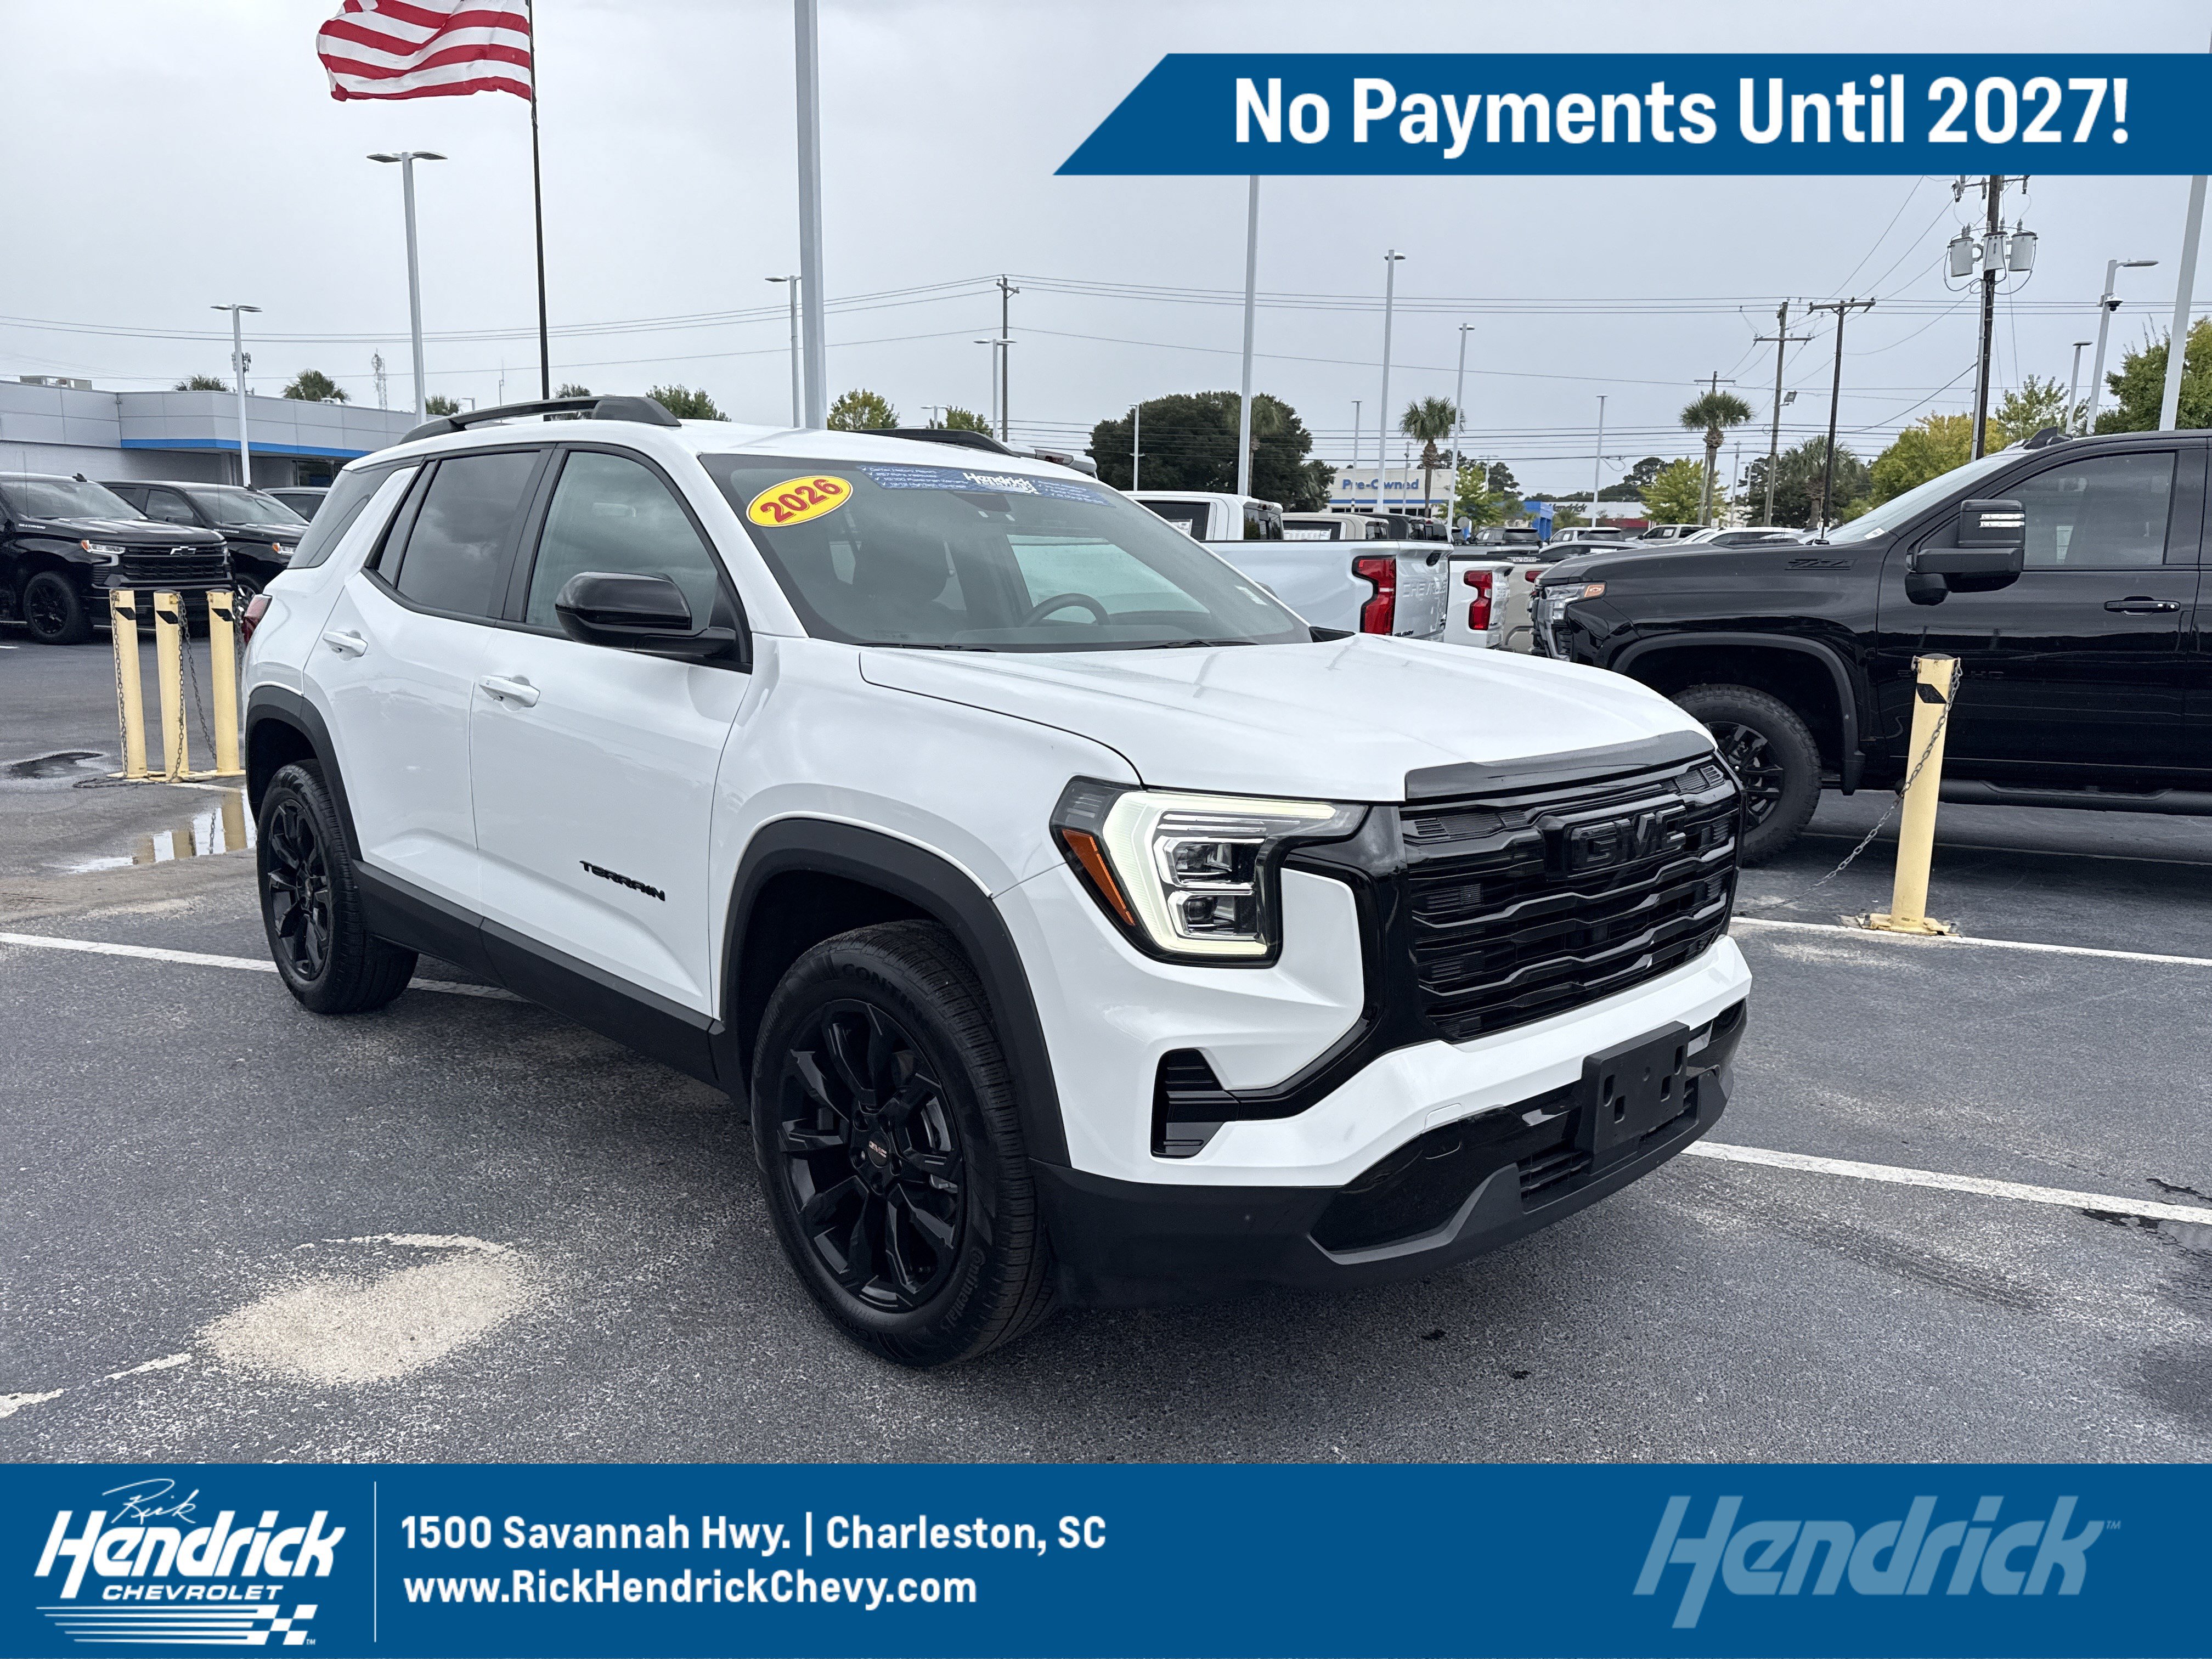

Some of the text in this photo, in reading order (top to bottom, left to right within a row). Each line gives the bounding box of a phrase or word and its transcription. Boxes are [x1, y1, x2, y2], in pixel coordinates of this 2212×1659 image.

[962, 472, 1031, 486] Hendrick
[760, 478, 843, 523] 2026
[1549, 503, 1587, 514] endrick
[1571, 805, 1686, 871] GMC
[579, 860, 665, 901] TERRAIN
